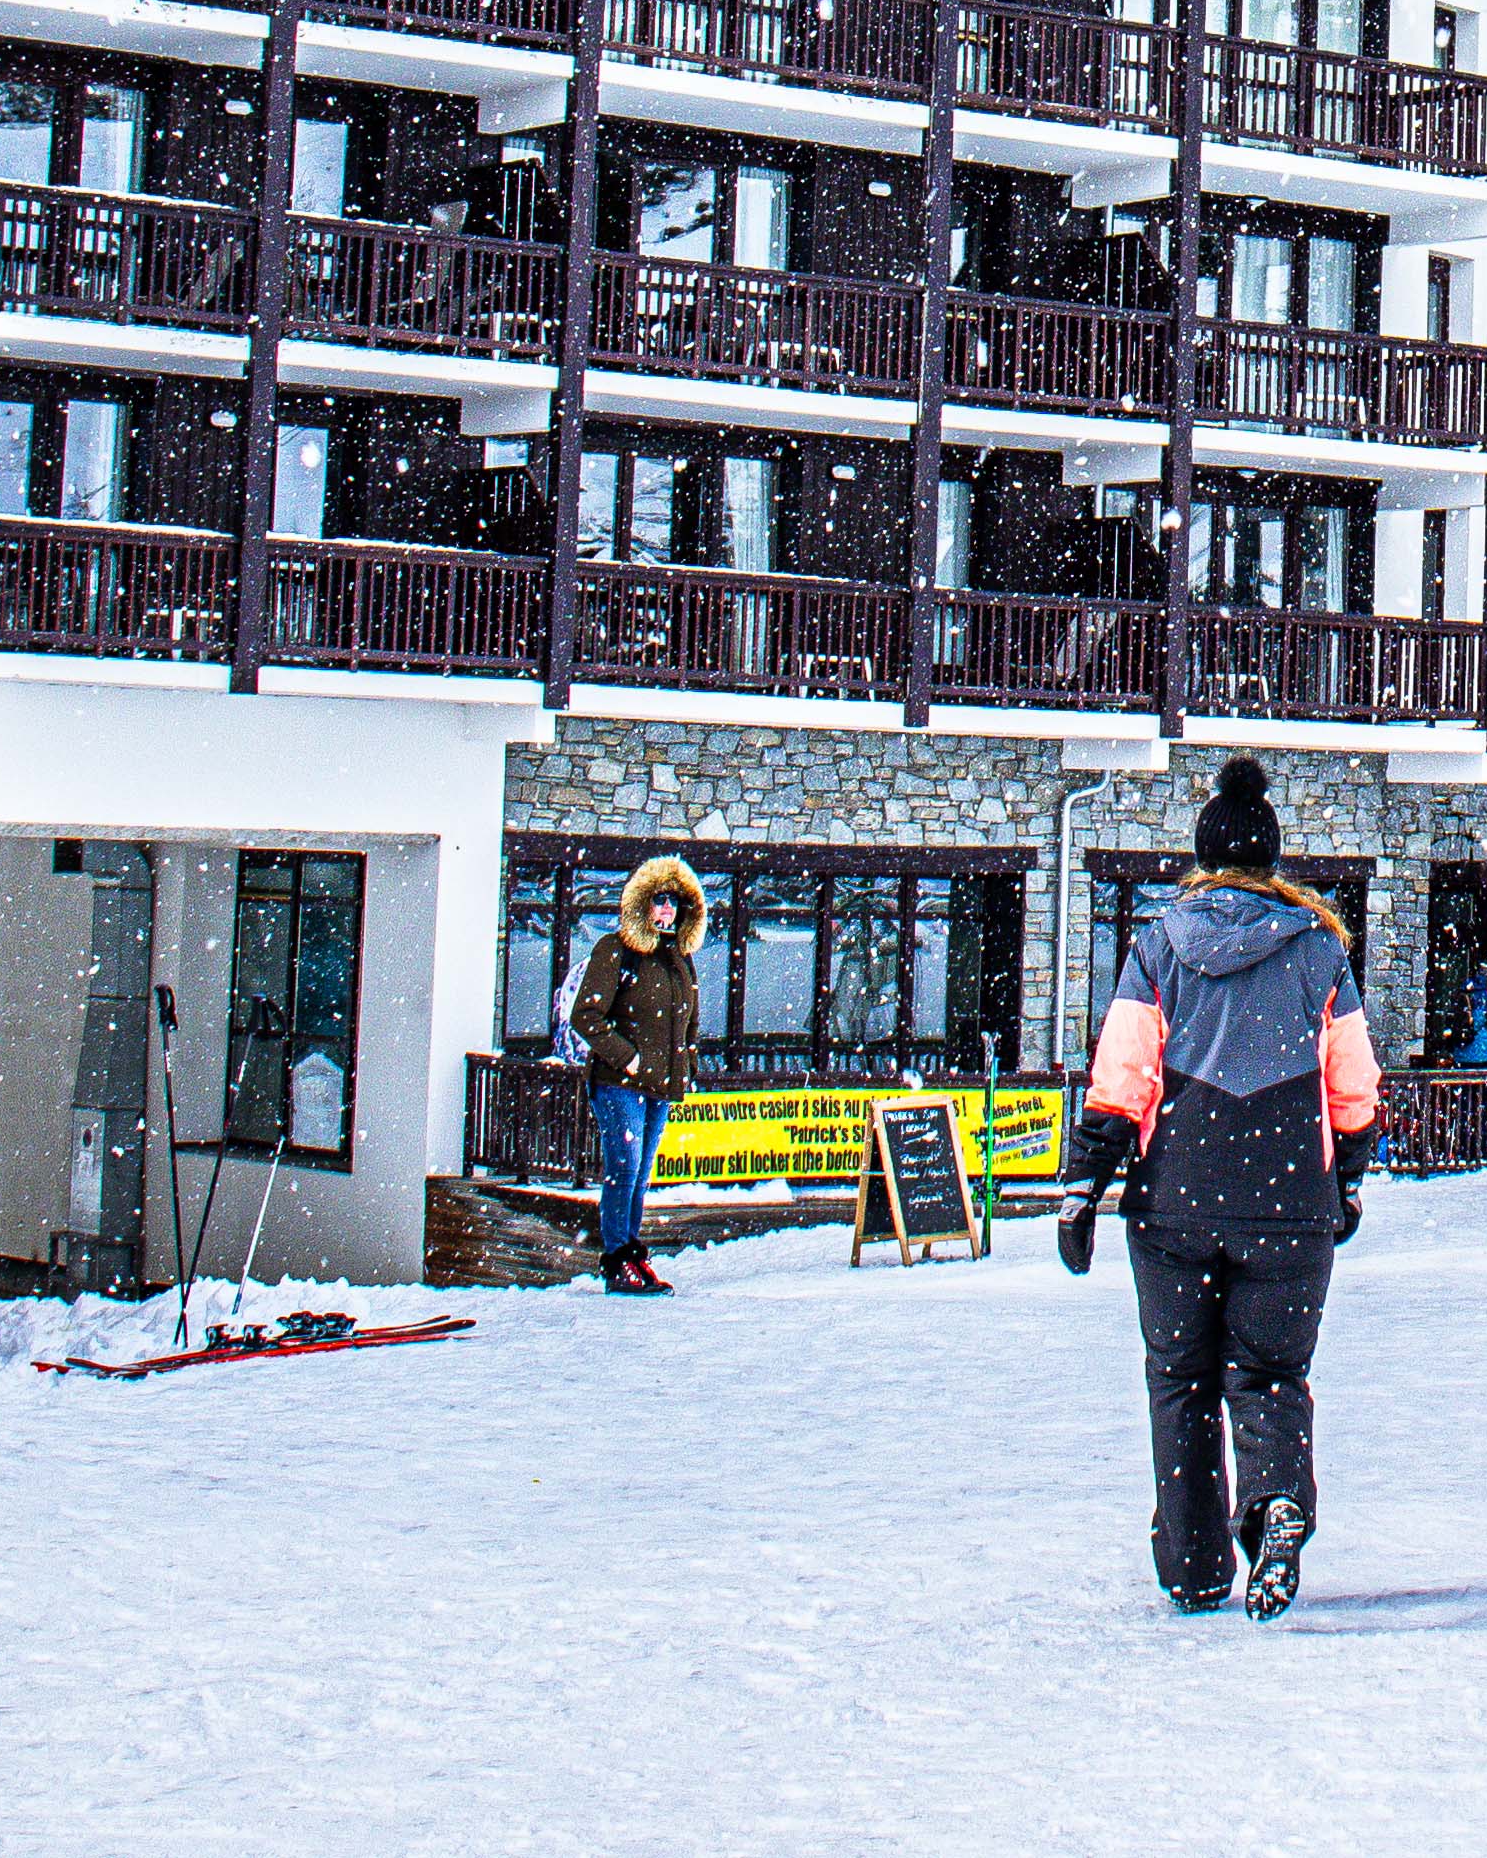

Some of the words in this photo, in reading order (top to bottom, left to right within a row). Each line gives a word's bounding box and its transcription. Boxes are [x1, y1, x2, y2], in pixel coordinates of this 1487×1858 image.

[721, 1099, 757, 1121] votre
[759, 1096, 800, 1120] casier
[812, 1095, 841, 1118] skis
[844, 1099, 860, 1118] au
[783, 1123, 849, 1144] "Patrick's
[657, 1152, 692, 1177] Book
[695, 1155, 726, 1179] your
[728, 1150, 748, 1174] ski
[750, 1148, 791, 1173] locker
[826, 1147, 864, 1171] botto
